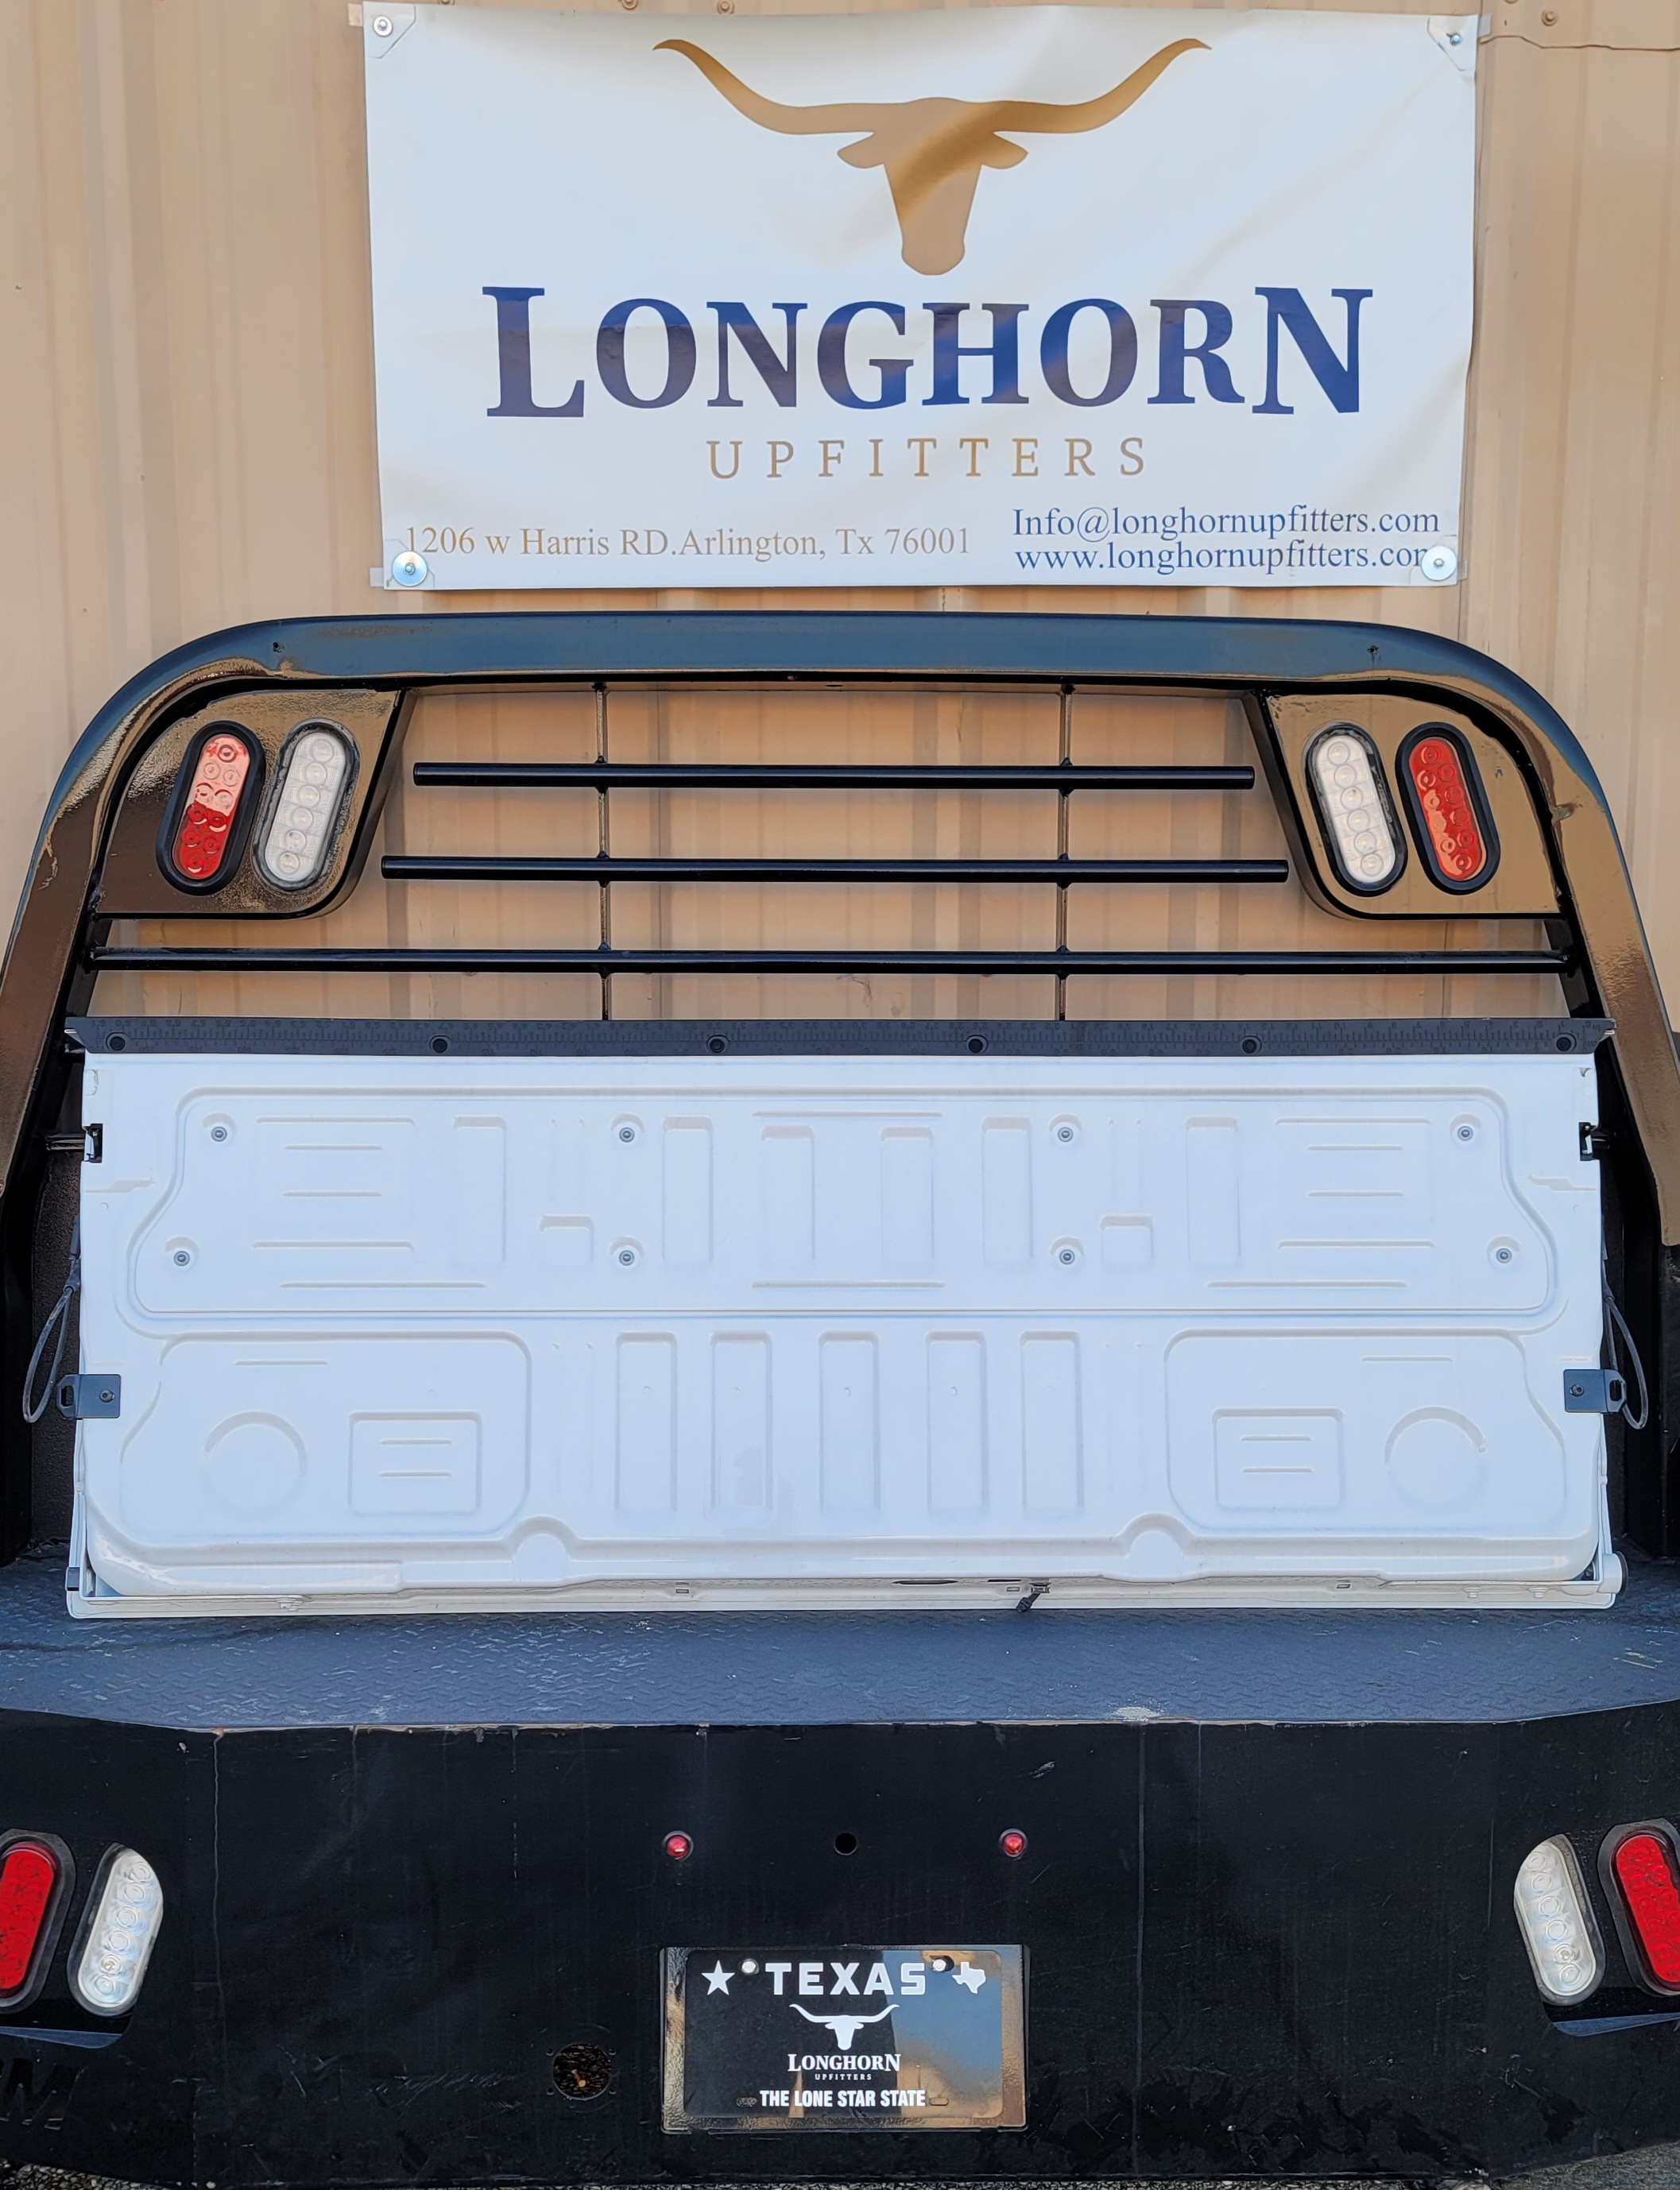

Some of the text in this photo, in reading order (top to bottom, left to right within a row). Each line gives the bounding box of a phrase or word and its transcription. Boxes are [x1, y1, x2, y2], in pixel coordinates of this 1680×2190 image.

[482, 286, 1373, 418] LONGHORN
[706, 437, 1144, 479] UPFITTERS
[1012, 504, 1440, 542] Info@longhornupfitters.com
[406, 526, 475, 554] 1206
[484, 535, 511, 555] w
[520, 528, 610, 555] Harris
[835, 528, 874, 555] Tx
[885, 527, 970, 555] 76001
[765, 1962, 926, 1995] TEXAS
[788, 2053, 901, 2072] LONGHORN
[760, 2089, 926, 2107] THE LONE STAR STATE
